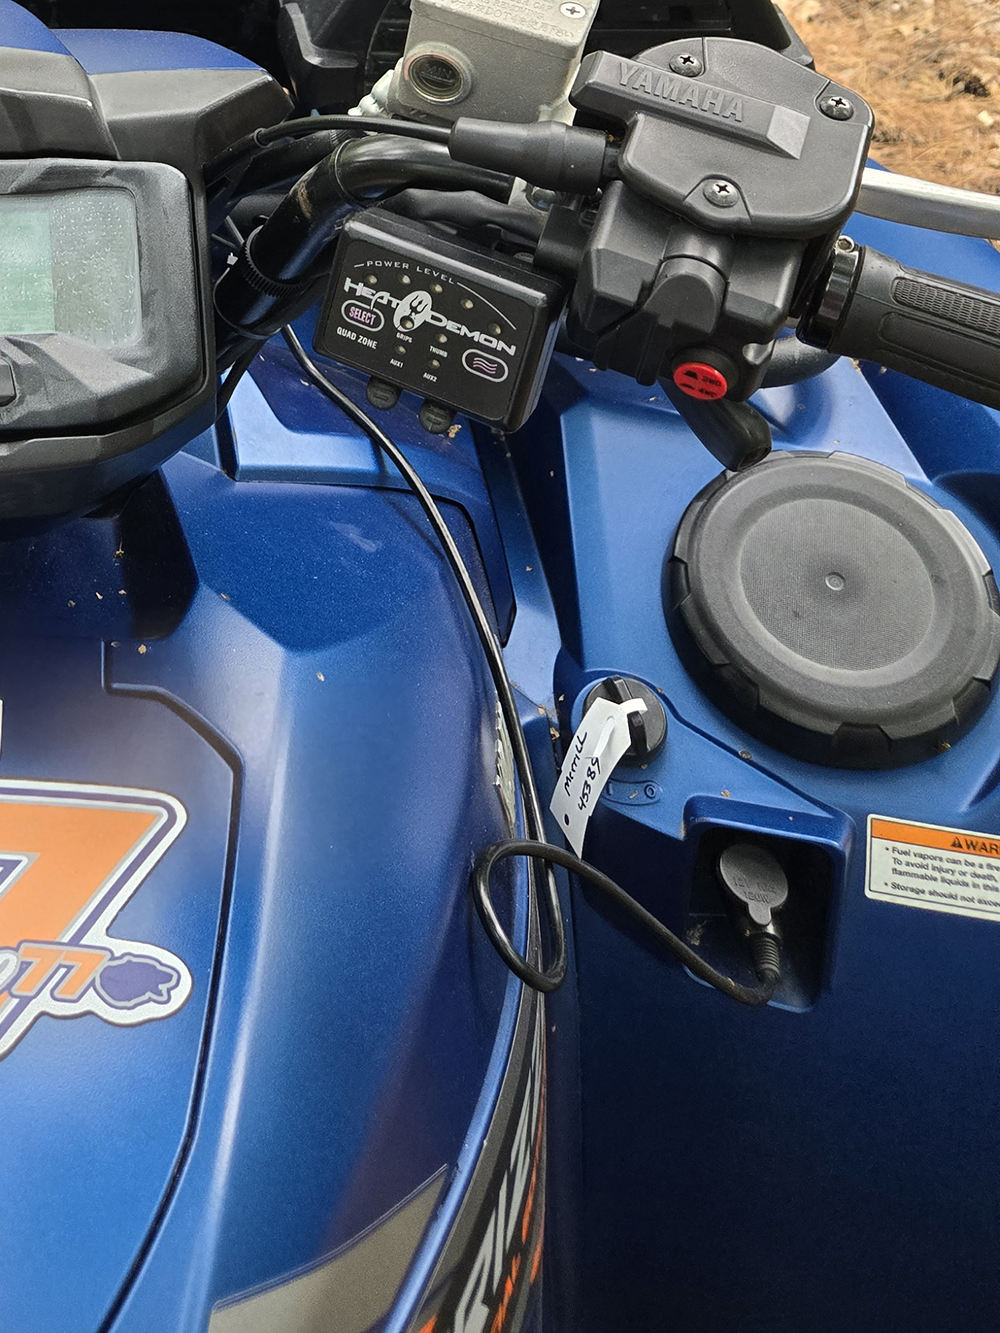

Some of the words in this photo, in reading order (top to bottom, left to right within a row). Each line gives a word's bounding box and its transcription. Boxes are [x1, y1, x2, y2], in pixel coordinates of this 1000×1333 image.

[618, 62, 745, 122] YAMAHA
[366, 260, 409, 270] POWER
[416, 266, 455, 284] LEVEL
[349, 306, 377, 326] SELECT
[336, 326, 357, 344] QUAD
[357, 334, 378, 350] ZONE
[427, 311, 516, 356] DEMON
[891, 846, 910, 856] Fuel
[913, 851, 943, 863] vapors
[945, 857, 961, 865] can
[964, 859, 975, 867] be
[891, 856, 902, 865] To
[904, 858, 928, 870] avoid
[930, 863, 955, 876] injury
[958, 869, 967, 877] or
